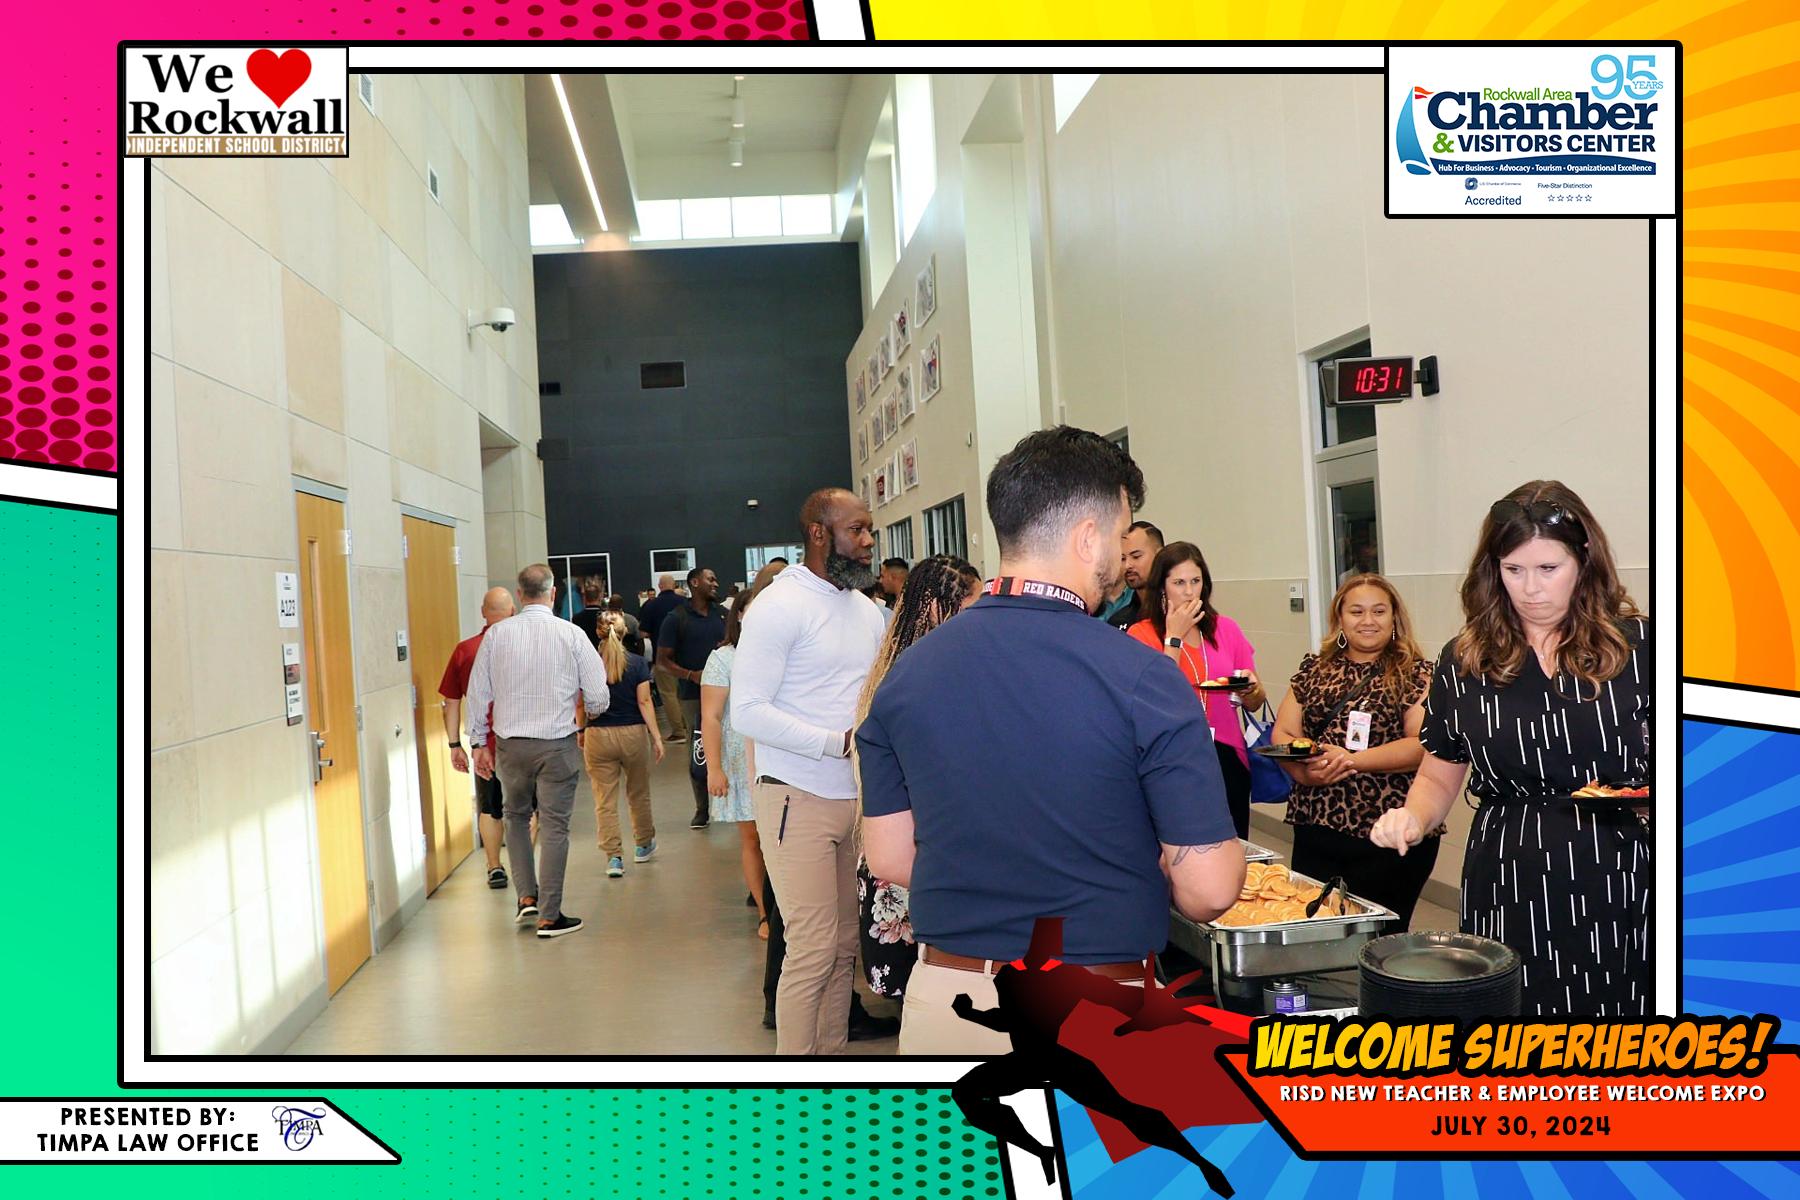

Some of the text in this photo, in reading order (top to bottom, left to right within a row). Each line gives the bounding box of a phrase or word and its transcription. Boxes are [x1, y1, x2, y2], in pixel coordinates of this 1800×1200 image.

[1355, 366, 1404, 393] 10:31
[1023, 582, 1085, 610] RED RAIDERS
